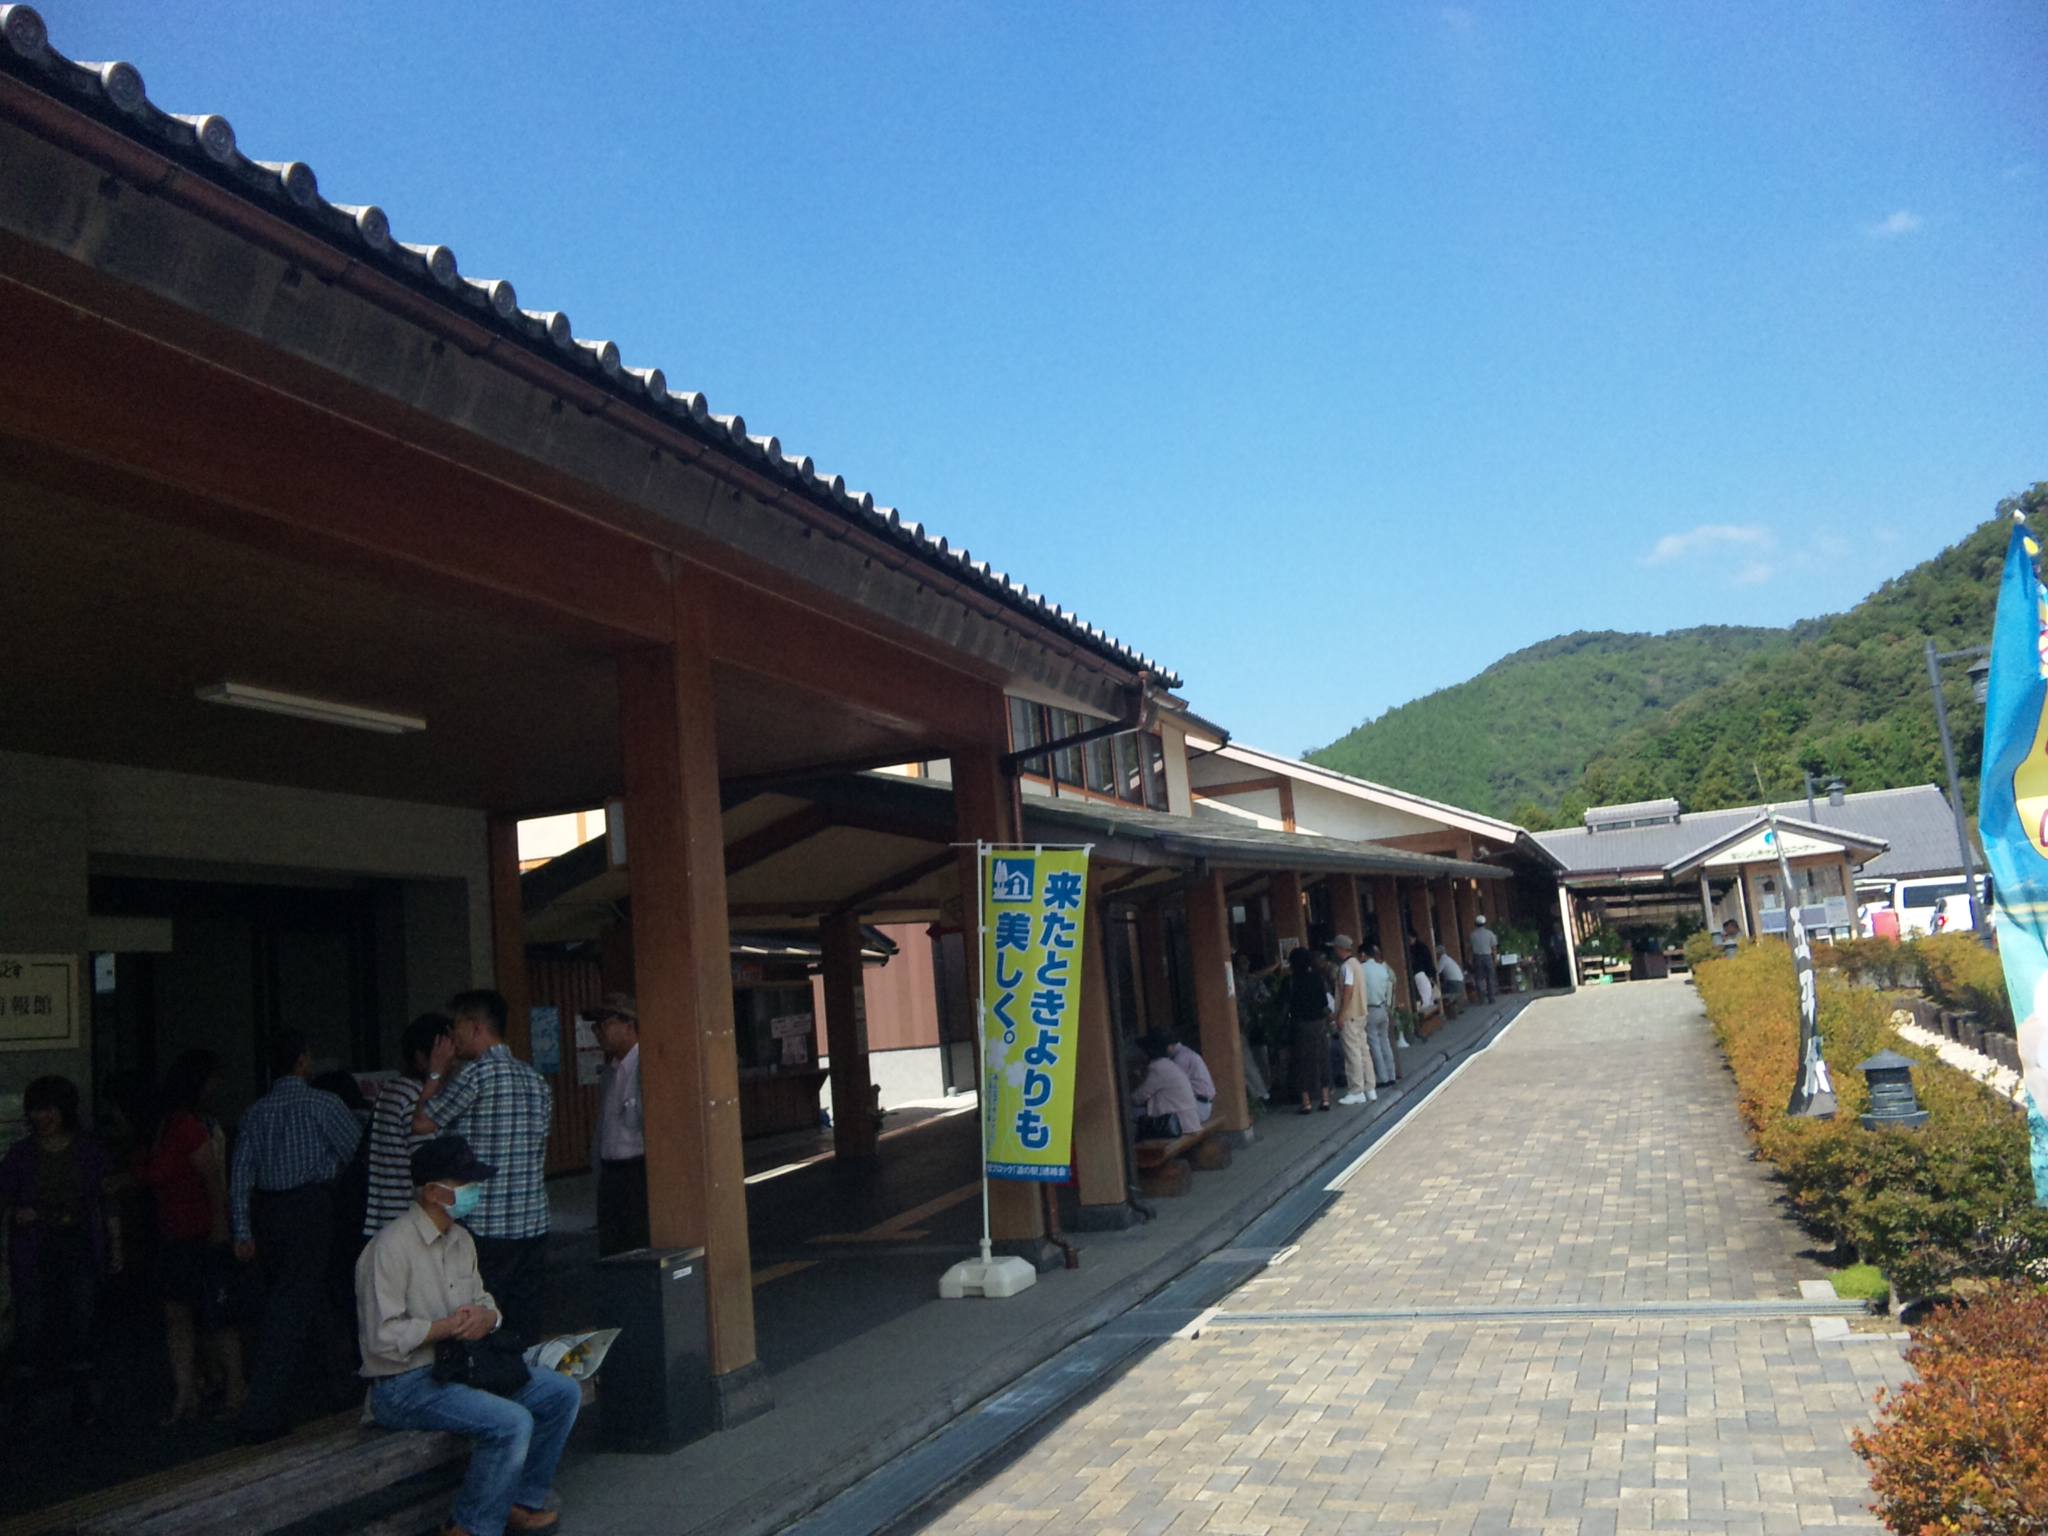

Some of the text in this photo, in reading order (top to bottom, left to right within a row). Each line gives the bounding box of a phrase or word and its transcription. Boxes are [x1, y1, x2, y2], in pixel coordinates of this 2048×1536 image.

[991, 911, 1032, 1046] 美しく。
[1015, 871, 1083, 1150] 来たときよりも
